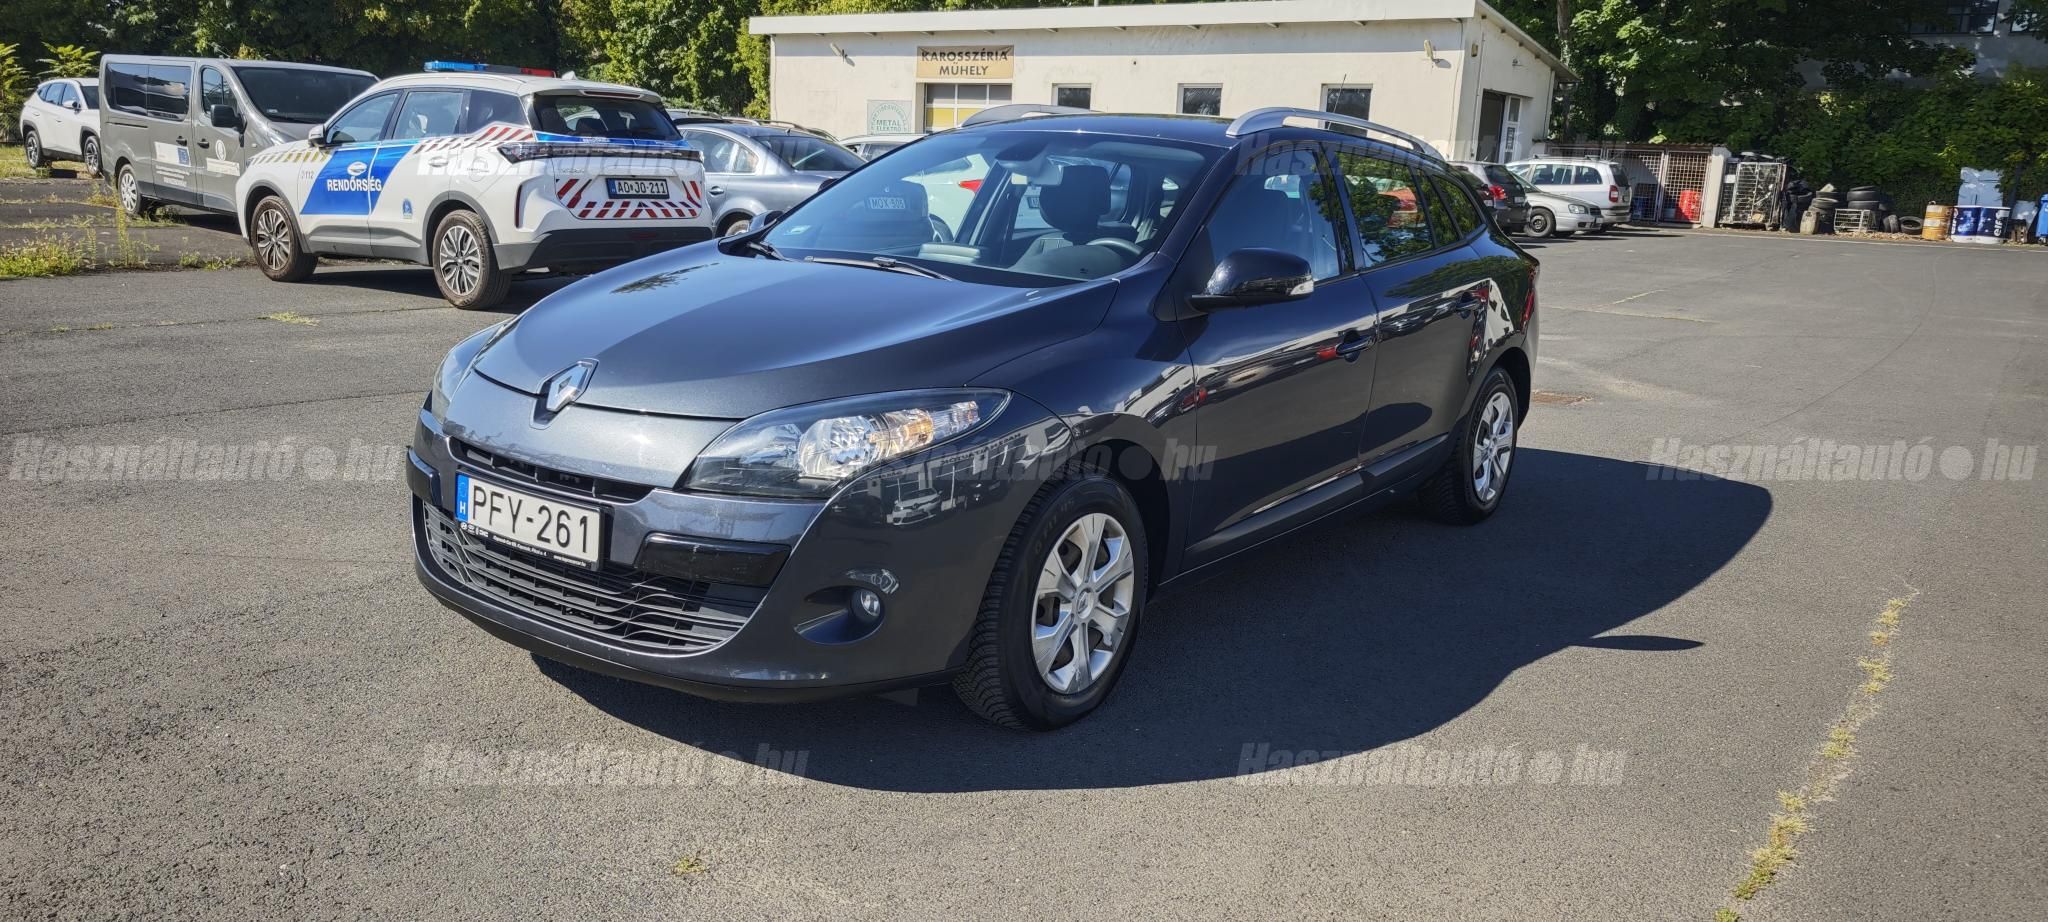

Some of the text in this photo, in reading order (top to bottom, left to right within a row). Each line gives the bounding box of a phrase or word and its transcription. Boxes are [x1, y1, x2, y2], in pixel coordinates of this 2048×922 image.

[921, 48, 1008, 61] KAROSSZÉRIA
[327, 175, 382, 191] RENDŐRSÉG
[472, 485, 588, 554] PFY-261
